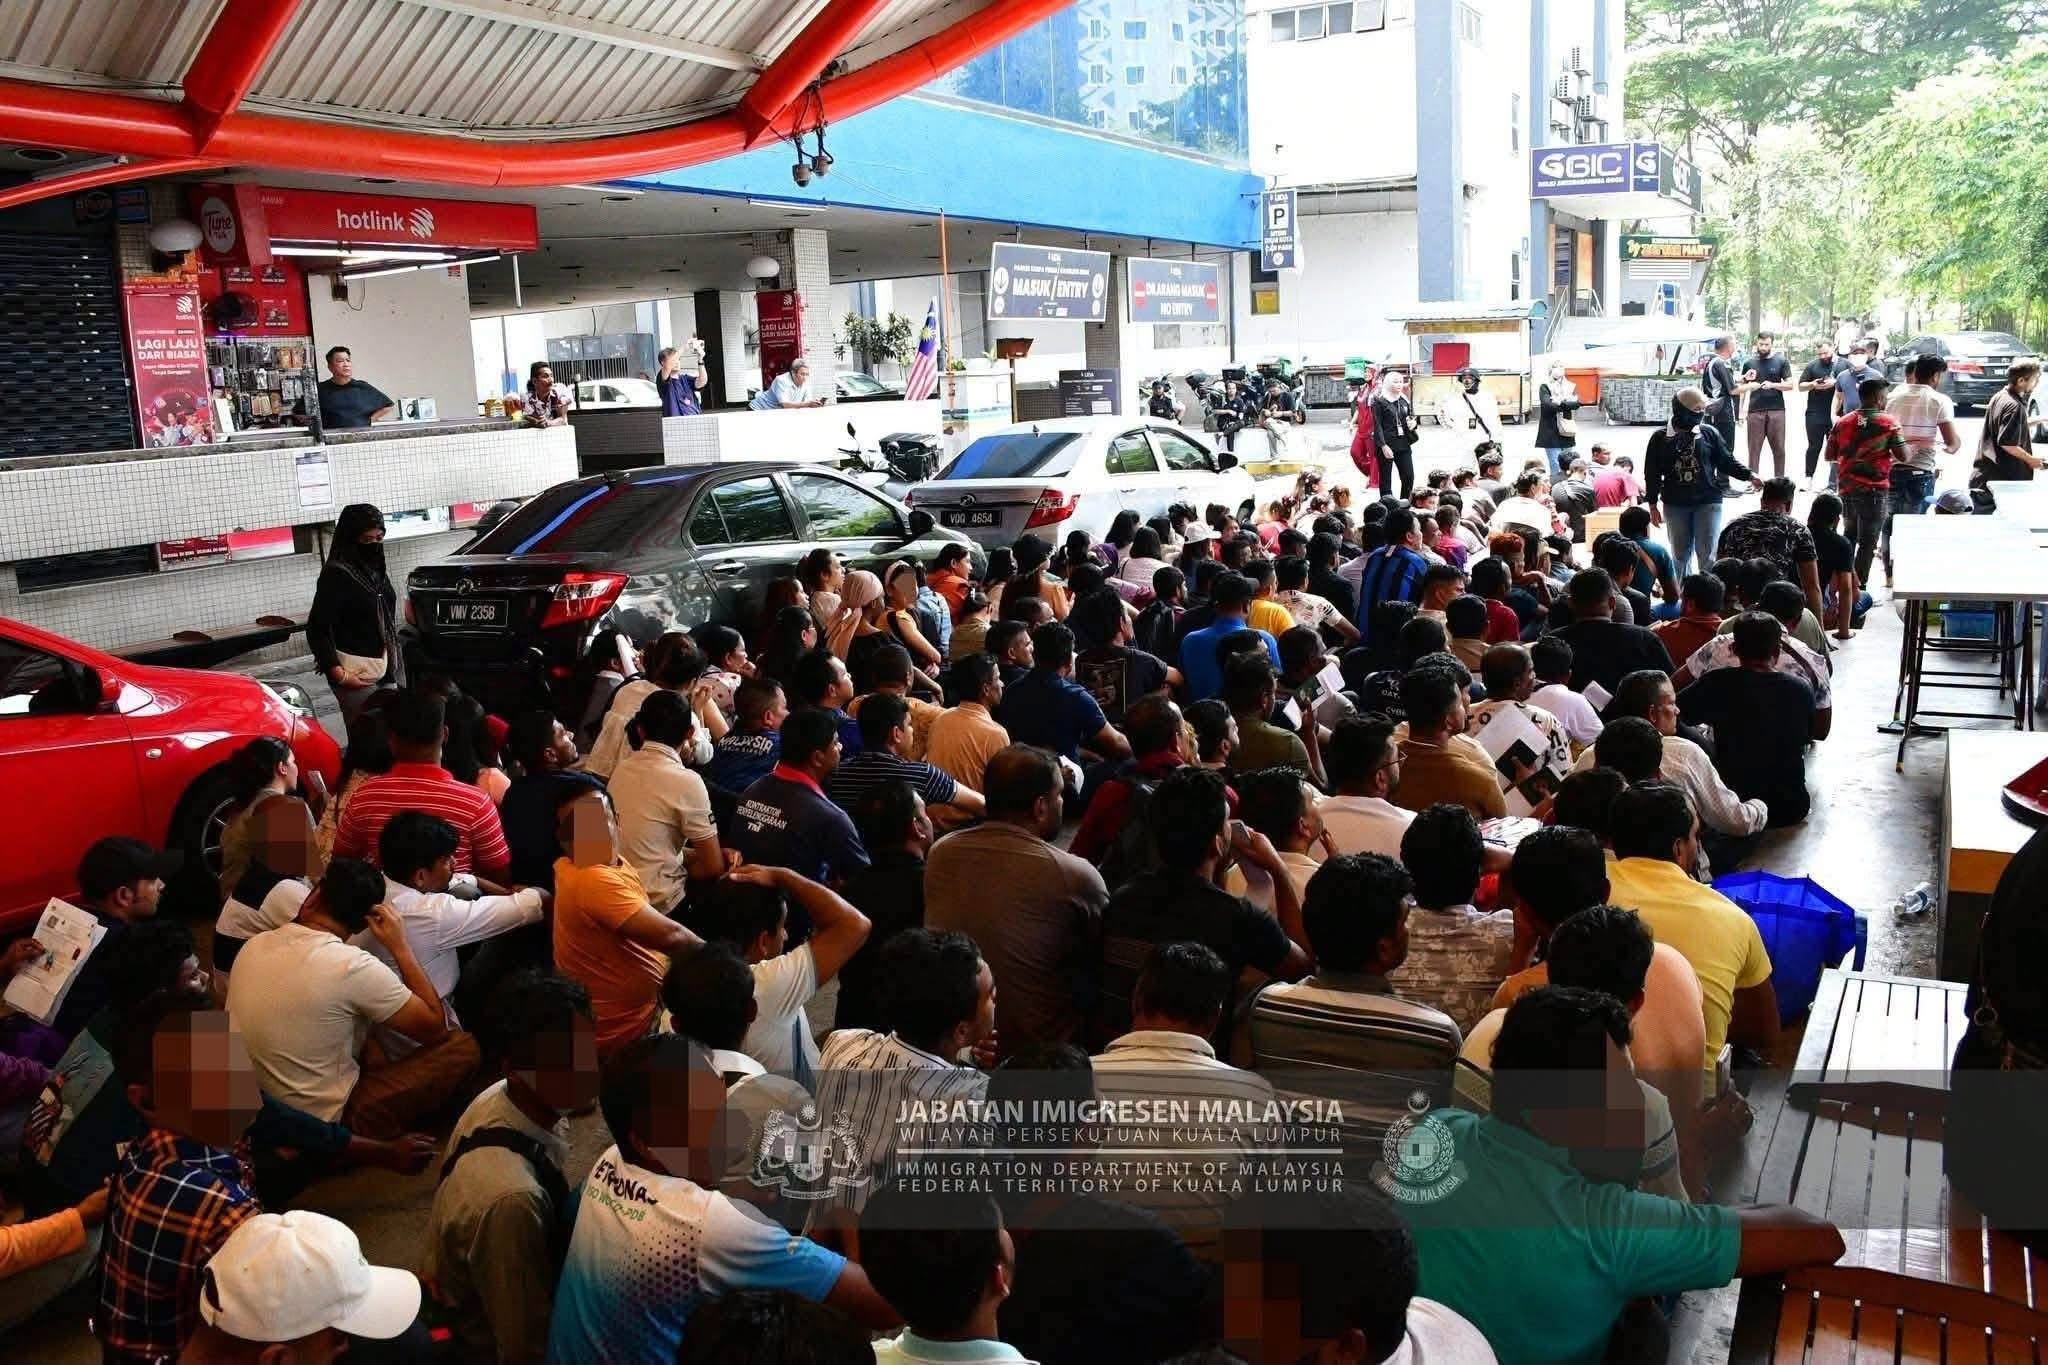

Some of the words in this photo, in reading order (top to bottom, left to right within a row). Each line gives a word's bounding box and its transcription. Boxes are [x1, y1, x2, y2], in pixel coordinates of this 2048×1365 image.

[336, 208, 405, 231] hotlink
[1274, 208, 1285, 225] P
[1181, 282, 1207, 297] MASUK
[136, 339, 167, 351] LAGI
[168, 337, 199, 350] LAJU
[137, 350, 165, 360] DARI
[972, 512, 993, 524] 4654
[450, 604, 468, 620] VMV
[470, 604, 496, 620] 2358
[745, 799, 782, 818] KONTRAKTOR
